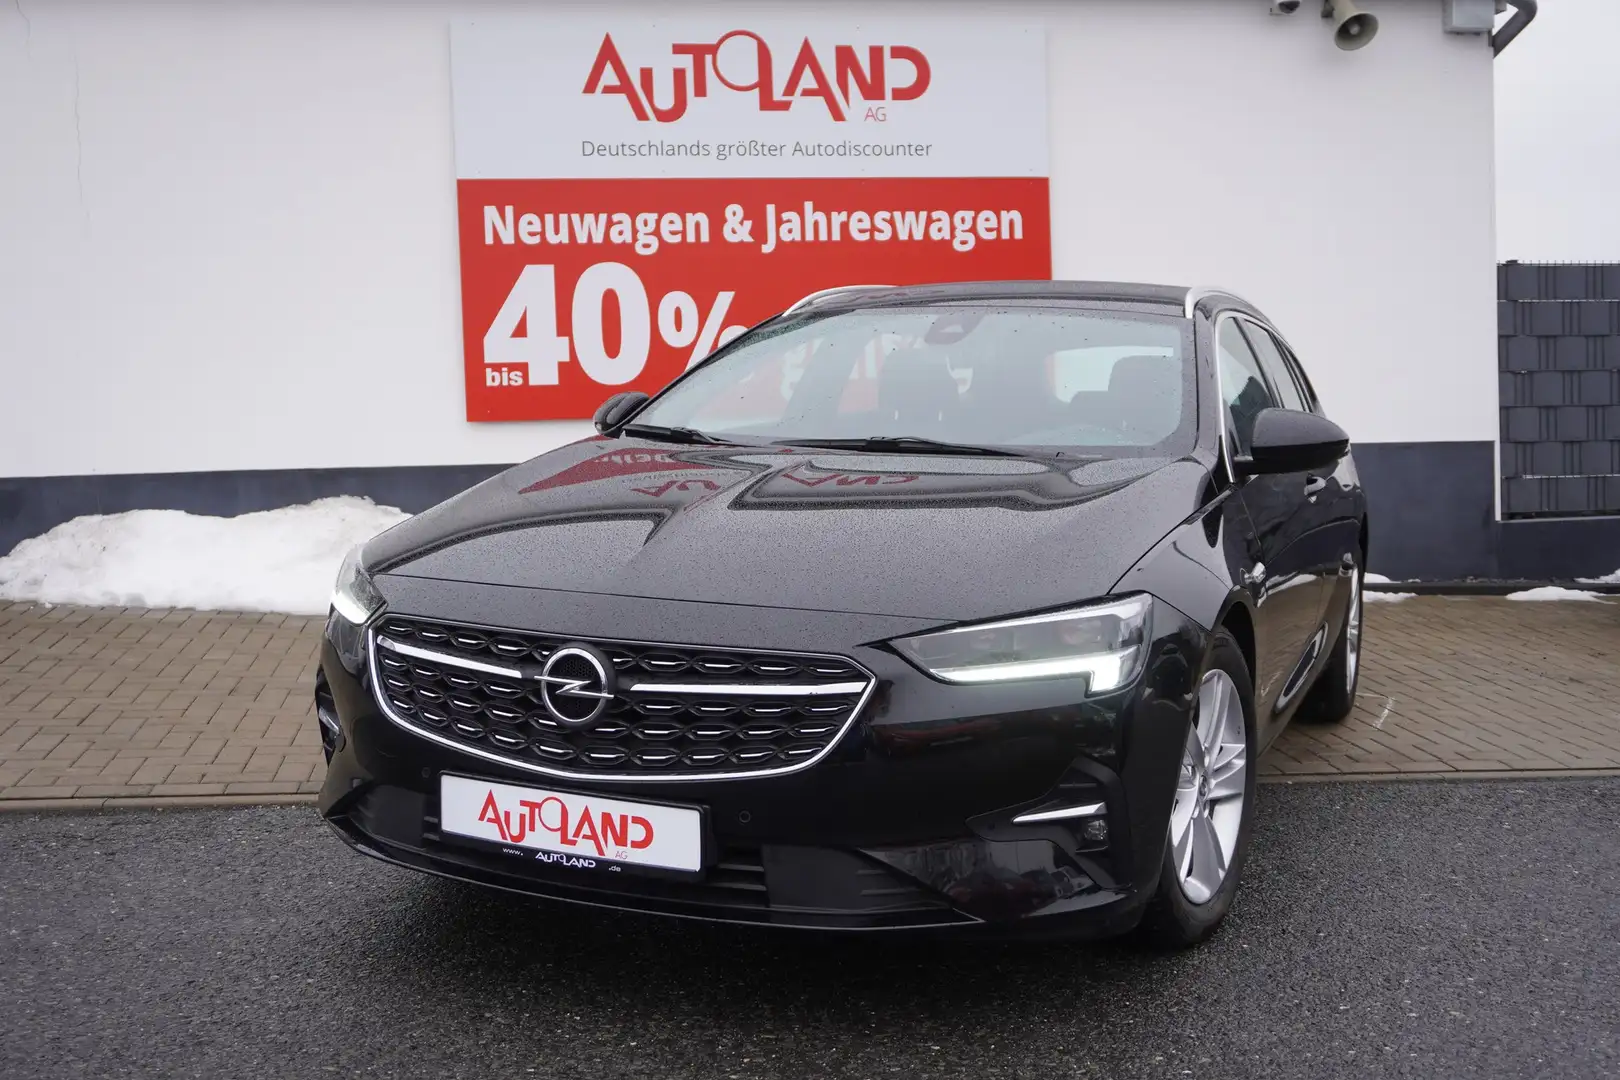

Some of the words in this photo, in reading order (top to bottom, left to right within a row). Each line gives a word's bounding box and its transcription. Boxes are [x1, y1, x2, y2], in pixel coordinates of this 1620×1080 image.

[582, 30, 931, 123] AUTOLAND
[863, 107, 887, 122] AG
[582, 141, 711, 157] Deutschlands
[717, 141, 786, 161] größter
[792, 141, 933, 158] Autodiscounter
[484, 205, 710, 255] Neuwagen
[723, 204, 754, 243] &
[762, 202, 1024, 254] Jahreswagen
[485, 368, 523, 387] bis
[478, 790, 654, 856] AUTOLAND
[615, 851, 628, 860] AG
